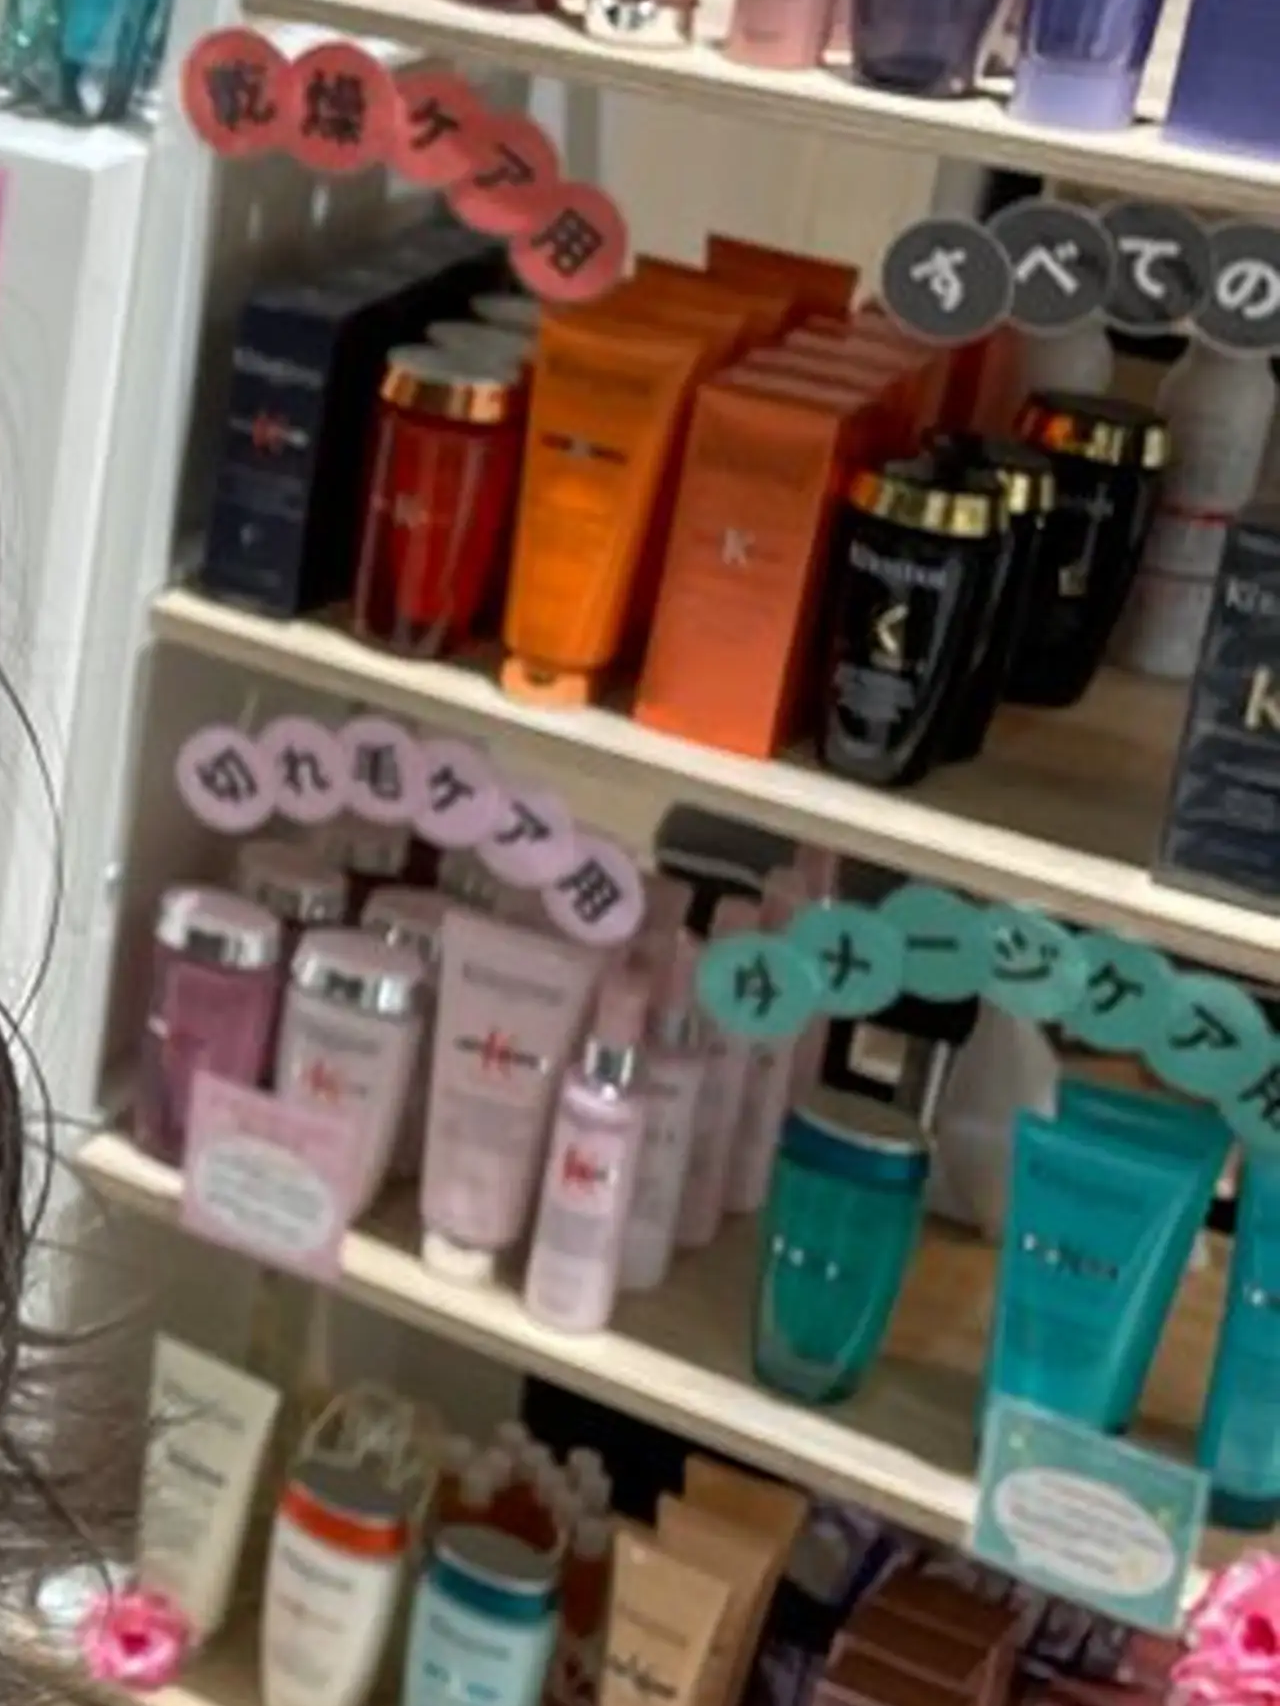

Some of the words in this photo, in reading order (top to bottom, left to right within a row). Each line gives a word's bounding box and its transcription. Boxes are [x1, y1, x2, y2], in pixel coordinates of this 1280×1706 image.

[204, 59, 605, 279] 乾燥ケア用
[909, 234, 1280, 319] すべての
[195, 743, 624, 926] 切れ毛ケア用
